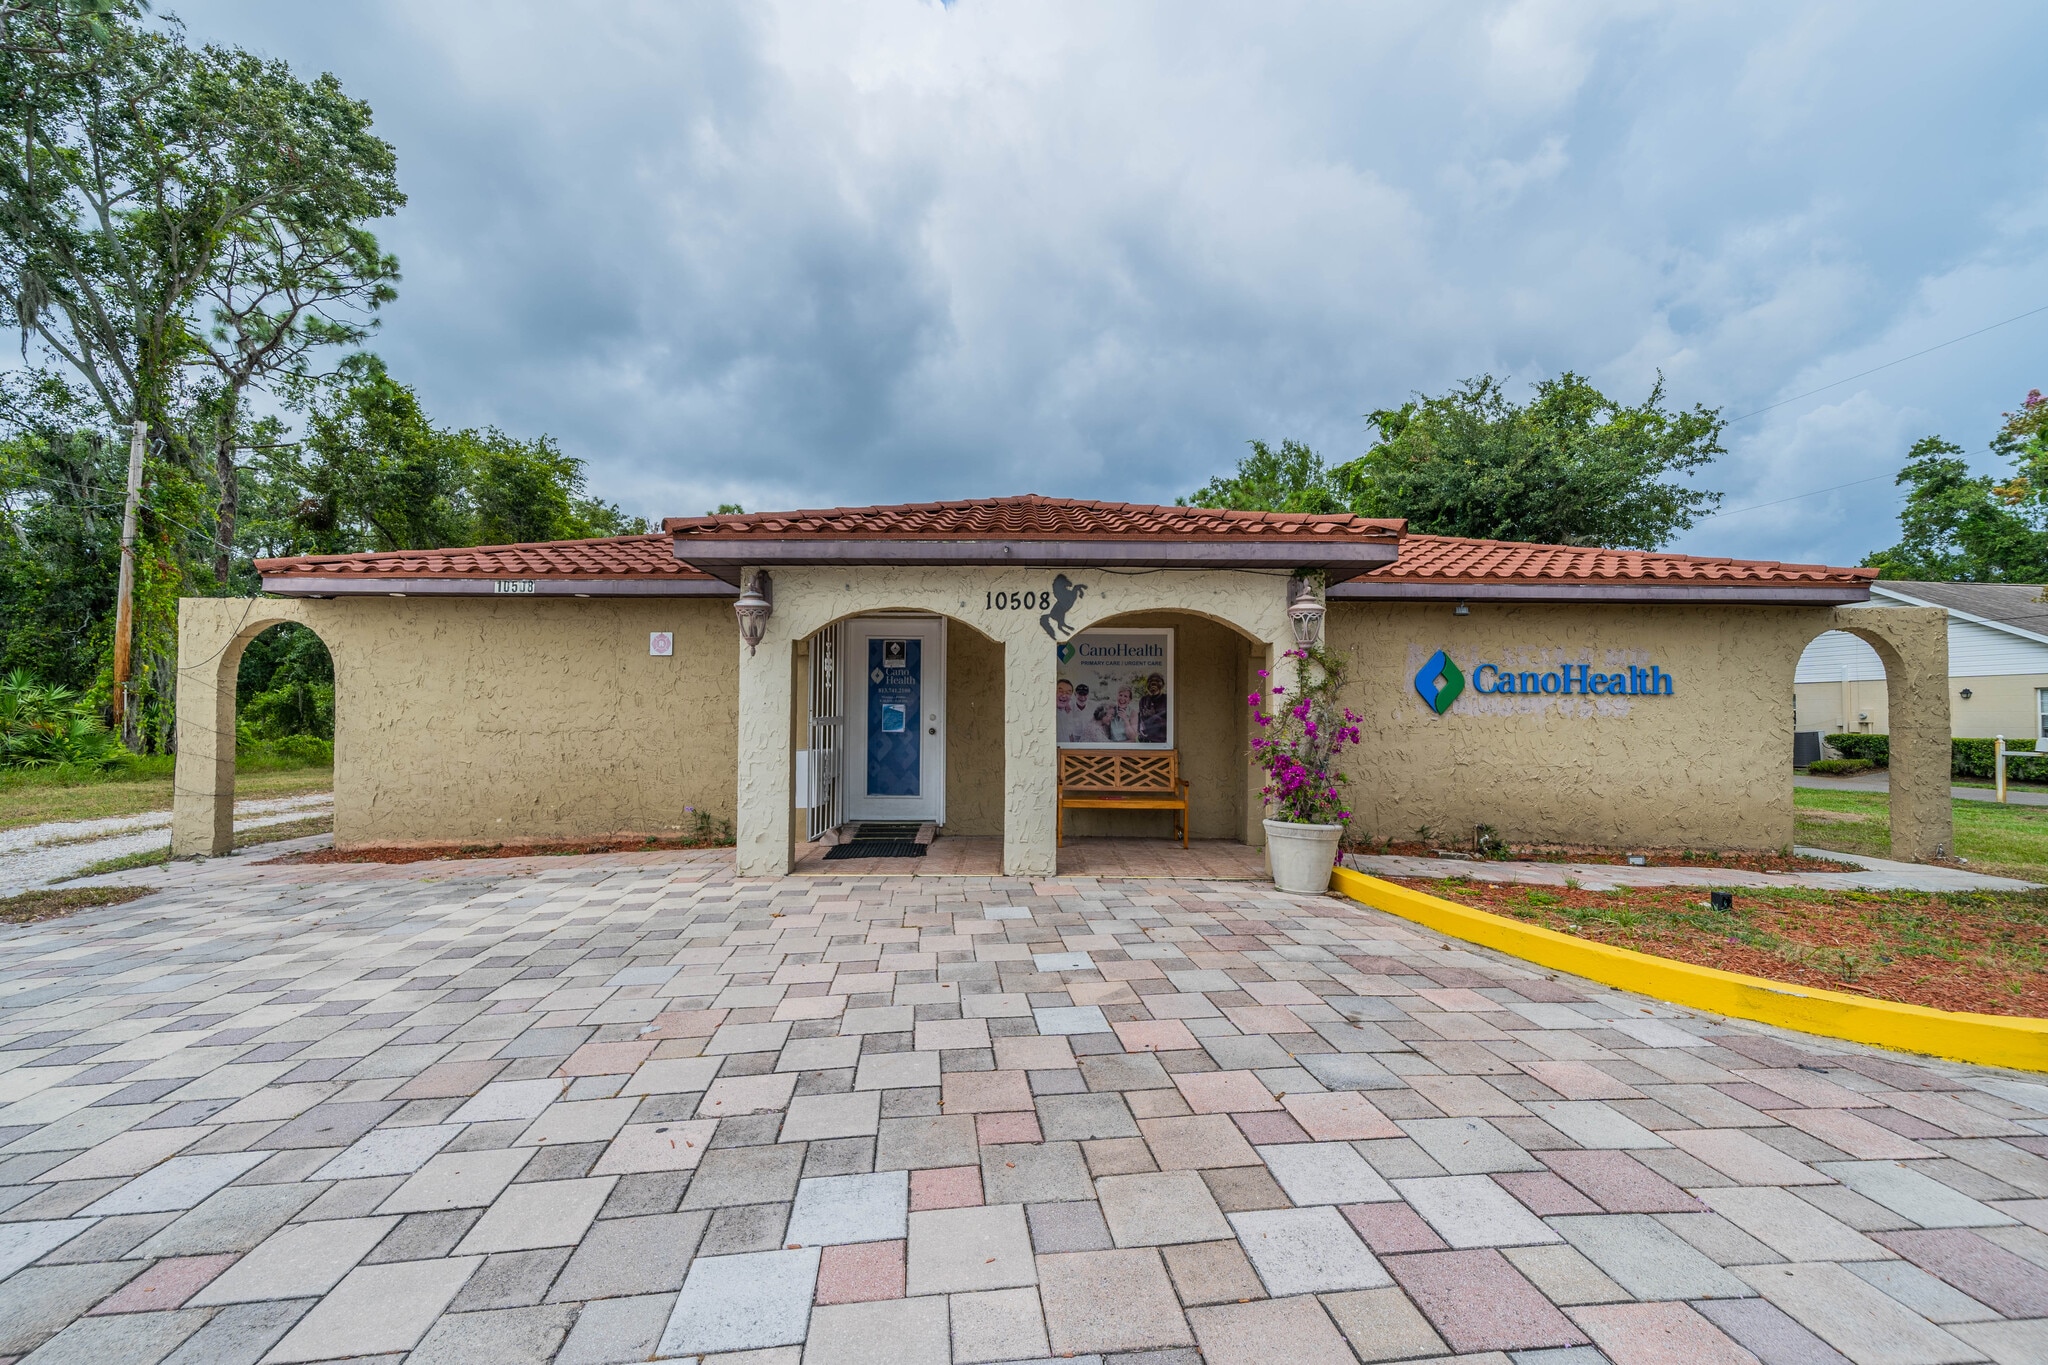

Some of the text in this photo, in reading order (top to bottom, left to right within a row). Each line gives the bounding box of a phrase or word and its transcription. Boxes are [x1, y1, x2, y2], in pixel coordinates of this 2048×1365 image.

[986, 591, 1050, 610] 10508
[1079, 643, 1163, 657] CanoHealth
[885, 667, 909, 676] Cano
[886, 676, 915, 685] Health
[1472, 663, 1675, 695] CanoHealth
